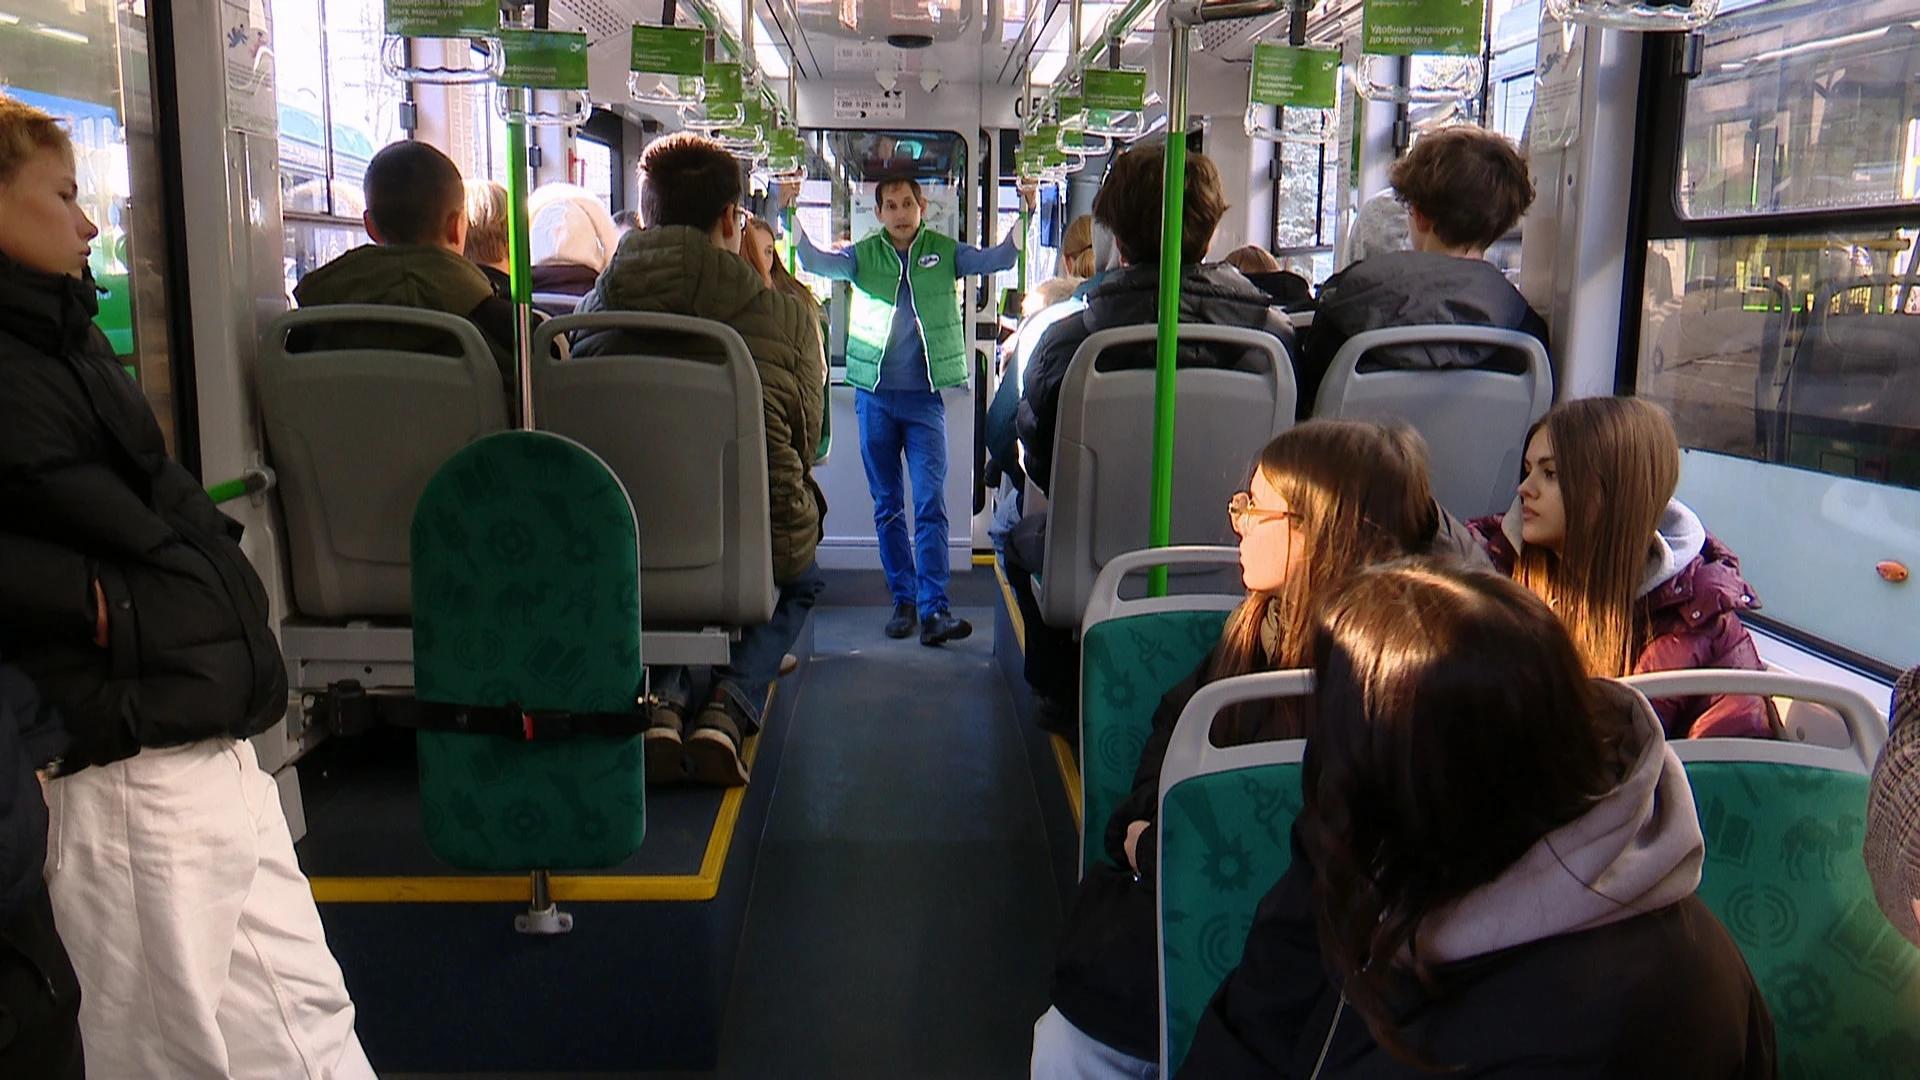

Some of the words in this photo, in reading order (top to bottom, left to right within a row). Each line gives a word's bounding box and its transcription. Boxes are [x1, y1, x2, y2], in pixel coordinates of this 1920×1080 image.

[1370, 24, 1412, 35] Удобные
[1414, 25, 1464, 36] маршруты
[1369, 35, 1382, 45] до
[1383, 35, 1433, 46] аэропорта
